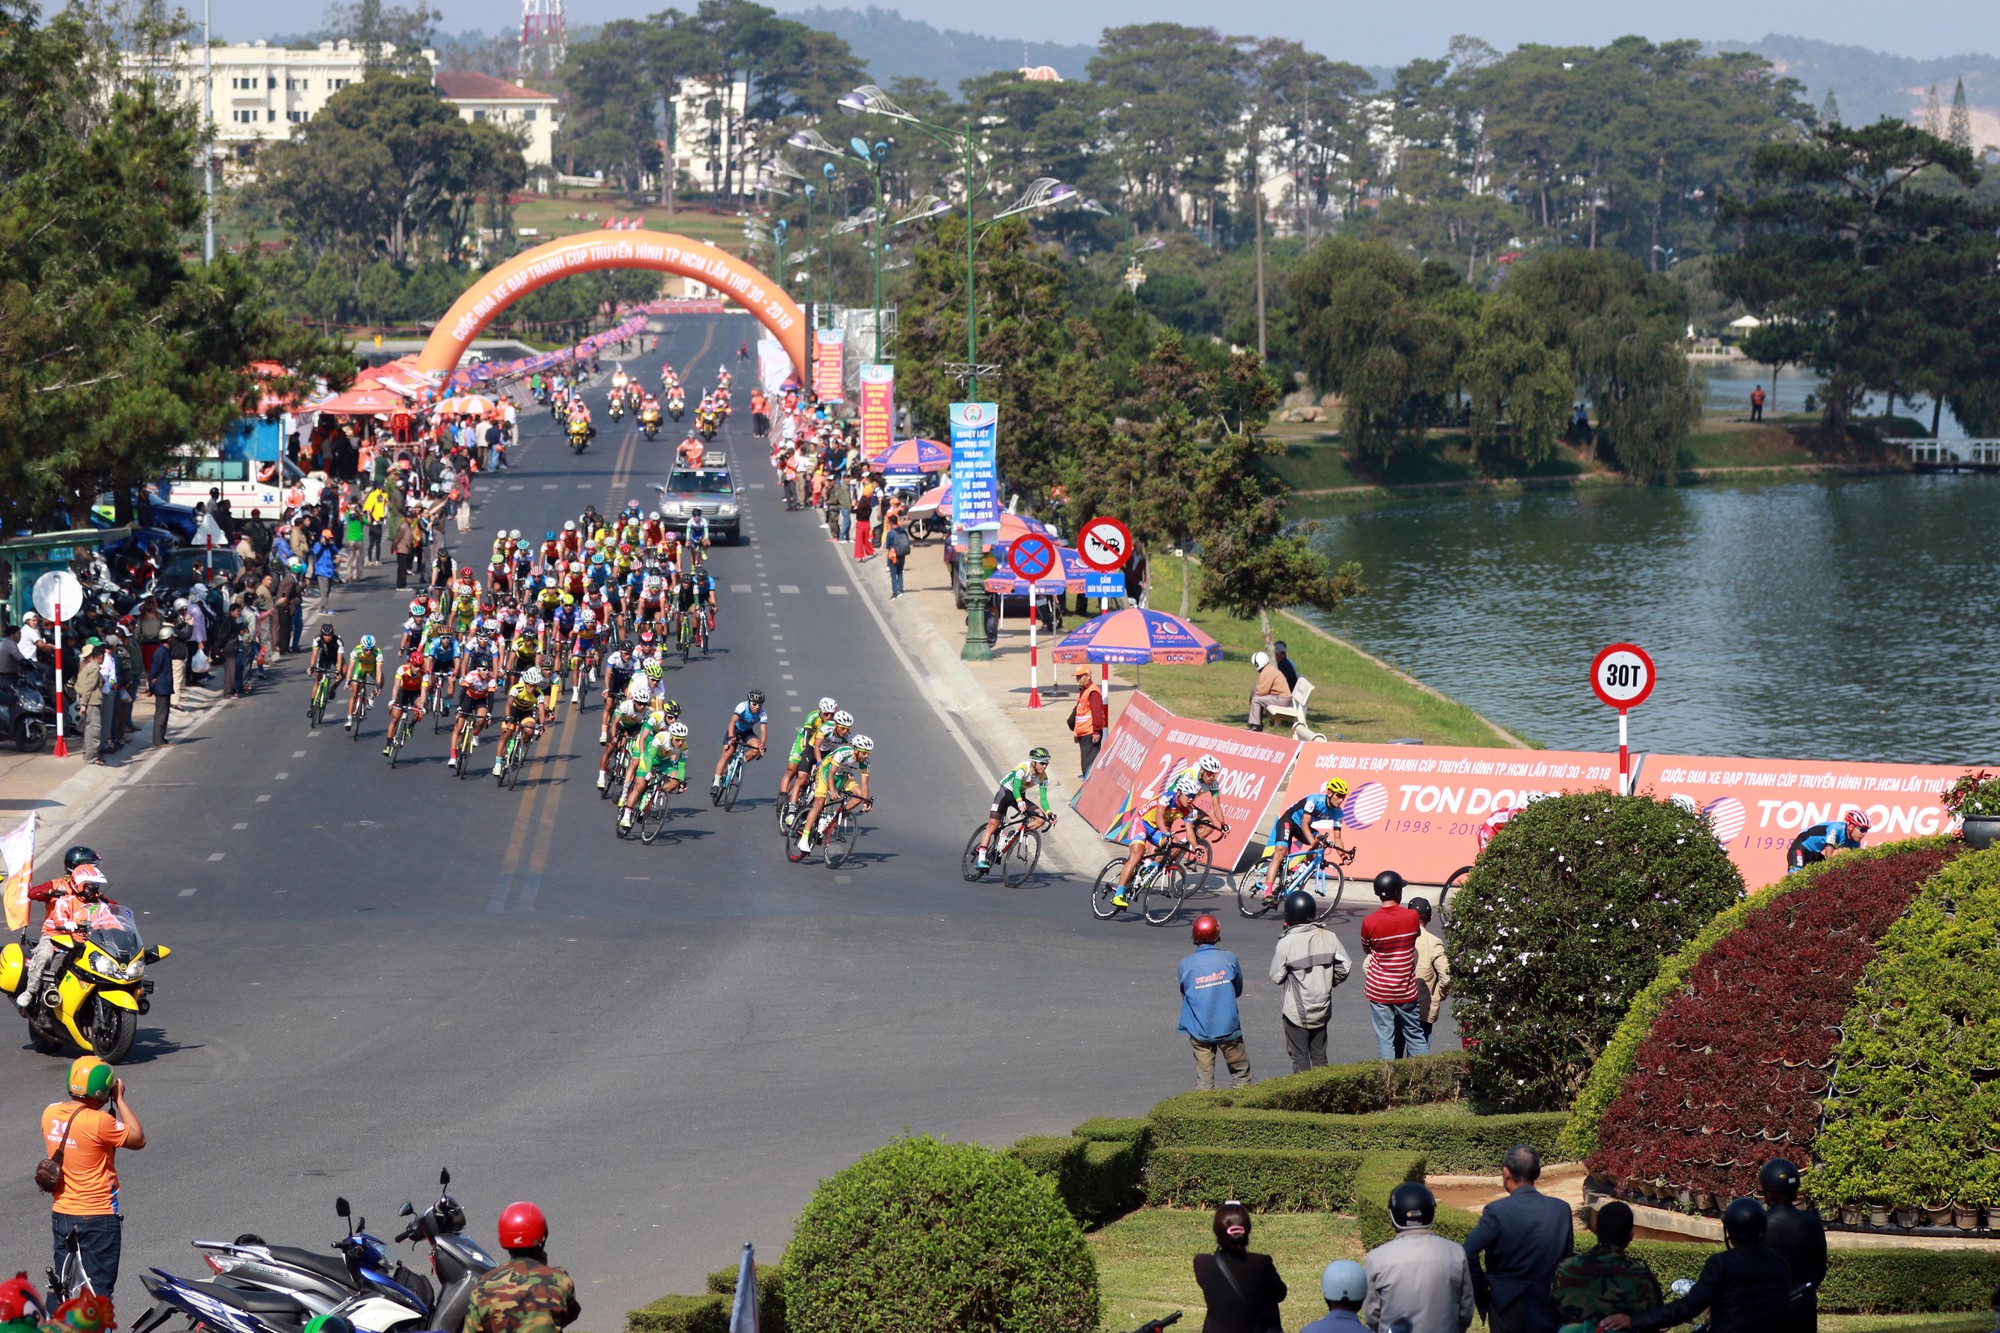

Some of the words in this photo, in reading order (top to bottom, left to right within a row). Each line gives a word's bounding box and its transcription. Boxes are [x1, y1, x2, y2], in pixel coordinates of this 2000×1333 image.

[452, 313, 478, 342] CUỘC
[473, 296, 497, 319] ĐUA
[492, 283, 510, 302] XE
[507, 274, 529, 290] ĐẠP
[528, 256, 566, 281] TRANH
[635, 243, 664, 259] HÌNH
[665, 247, 680, 263] TP
[679, 252, 706, 271] HCM
[746, 285, 764, 304] 30
[765, 301, 795, 330] 2018
[964, 471, 974, 479] AN
[1606, 664, 1640, 687] 30T
[1315, 754, 1339, 771] CUỘC
[1338, 756, 1357, 770] ĐUA
[1357, 756, 1370, 769] XE
[1370, 758, 1388, 773] ĐẠP
[1388, 758, 1418, 772] TRANH
[1418, 758, 1437, 772] CÚP
[1471, 760, 1495, 775] HÌNH
[1494, 762, 1530, 777] TP.HCM
[1549, 763, 1570, 779] THỨ
[1566, 766, 1581, 780] 30
[1586, 766, 1612, 780] 2018
[1661, 767, 1687, 785] CUỘC
[1687, 770, 1707, 784] ĐUA
[1708, 771, 1723, 784] XE
[1722, 772, 1743, 788] ĐẠP
[1744, 772, 1777, 786] TRANH
[1777, 772, 1798, 787] CÚP
[1836, 774, 1863, 790] HÌNH
[1863, 776, 1901, 791] TP.HCM
[1924, 776, 1944, 793] THỨ
[1400, 784, 1466, 814] TON
[1395, 820, 1431, 834] 1998
[1449, 822, 1482, 836] 2018
[1757, 800, 1832, 830] TON
